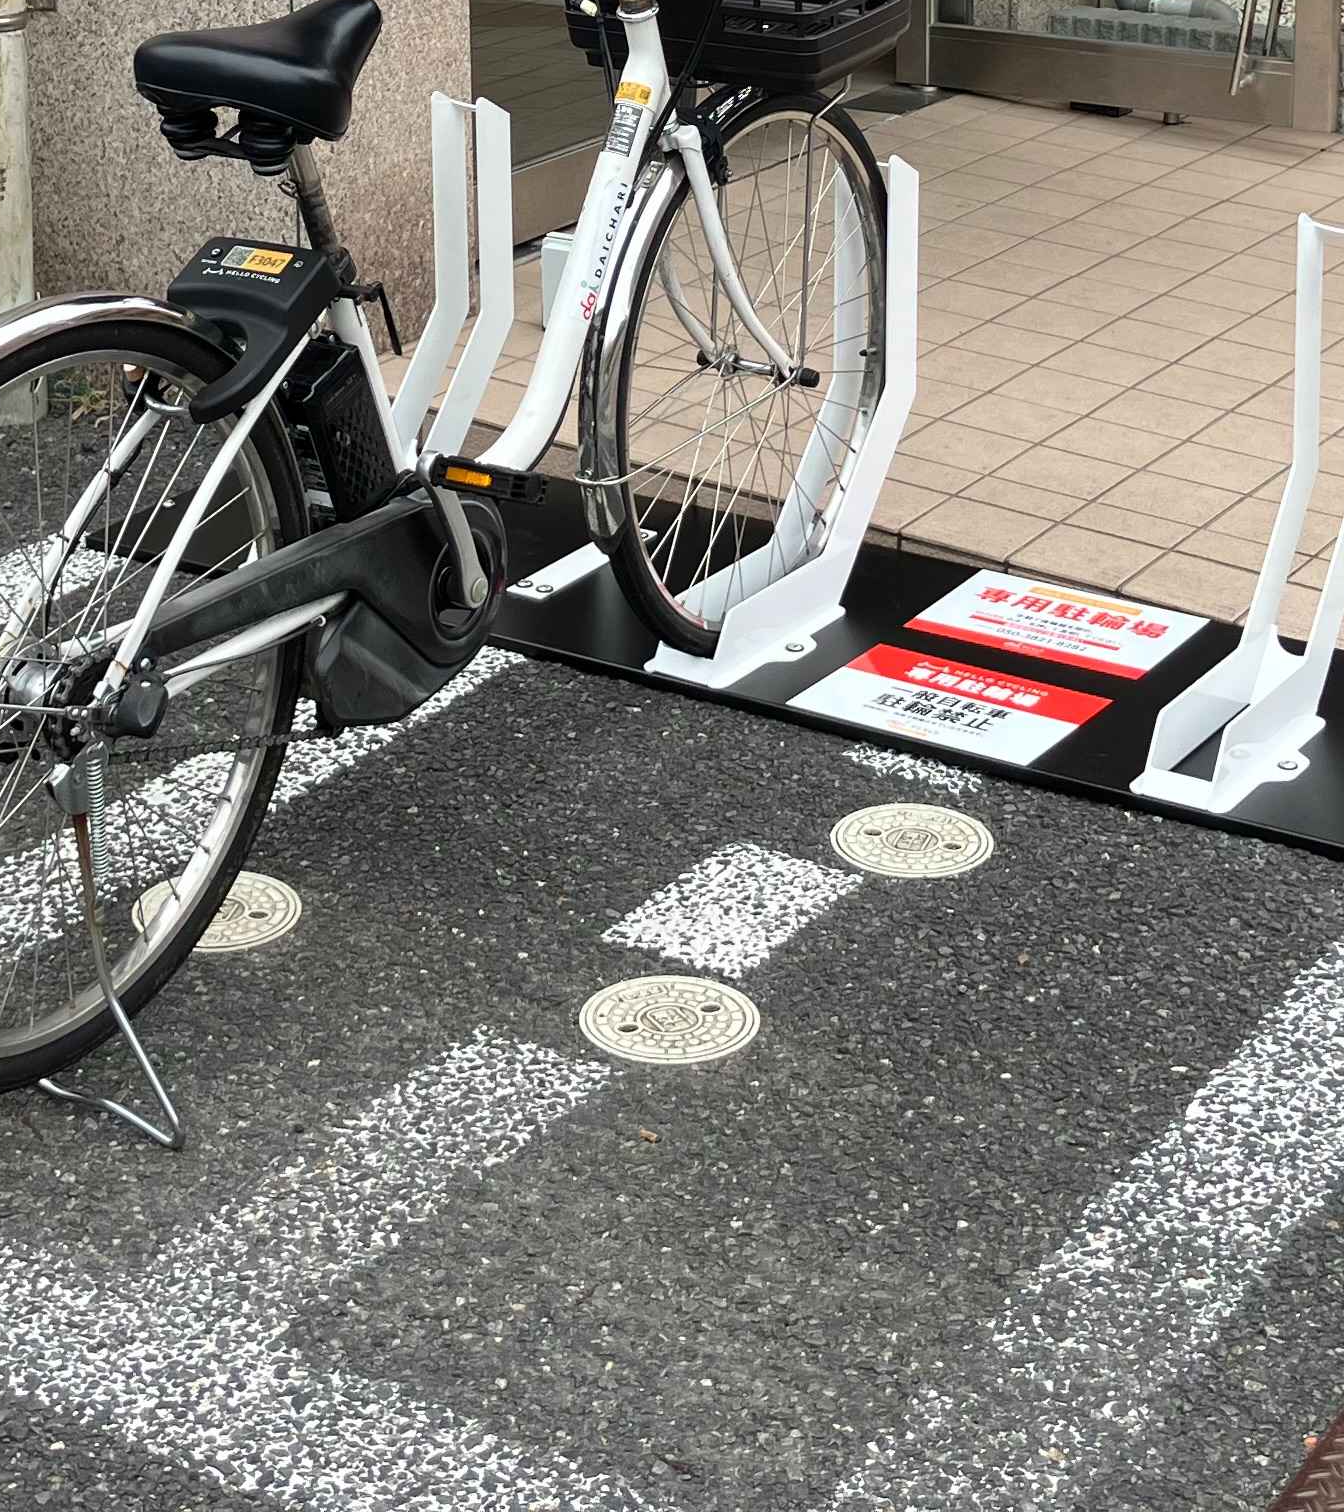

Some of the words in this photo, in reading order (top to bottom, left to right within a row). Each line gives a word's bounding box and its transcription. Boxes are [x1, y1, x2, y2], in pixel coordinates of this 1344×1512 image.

[594, 182, 629, 279] DAICHARI
[976, 586, 1169, 640] 専用駐輪場
[871, 692, 995, 732] 駐輪禁止
[891, 686, 1013, 720] 一般自転車
